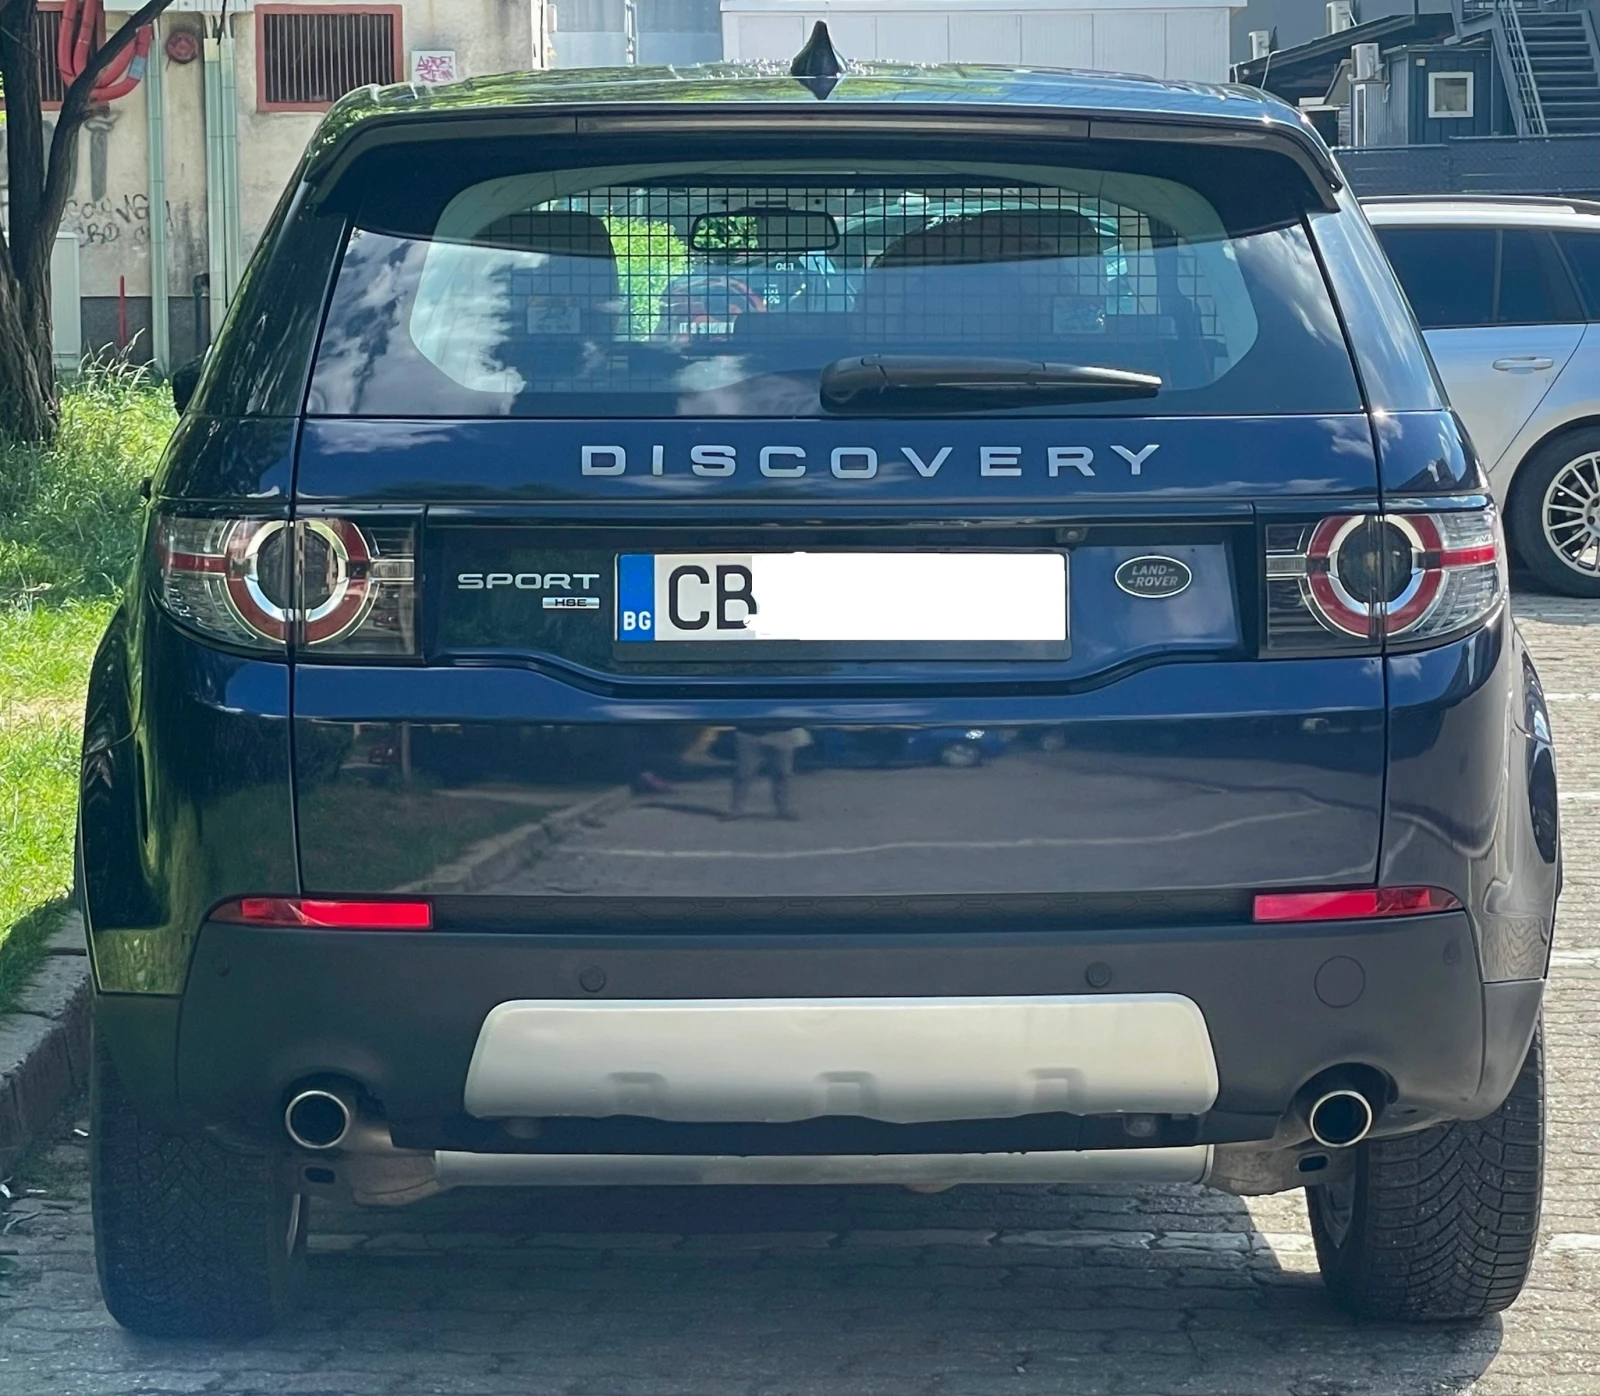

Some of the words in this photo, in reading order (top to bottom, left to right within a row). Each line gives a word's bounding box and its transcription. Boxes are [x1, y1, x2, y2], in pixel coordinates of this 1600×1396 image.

[581, 444, 1160, 479] DISCOVERY
[457, 573, 600, 589] SPORT
[554, 598, 588, 608] HSE
[668, 564, 758, 630] CB
[623, 611, 651, 631] BG
